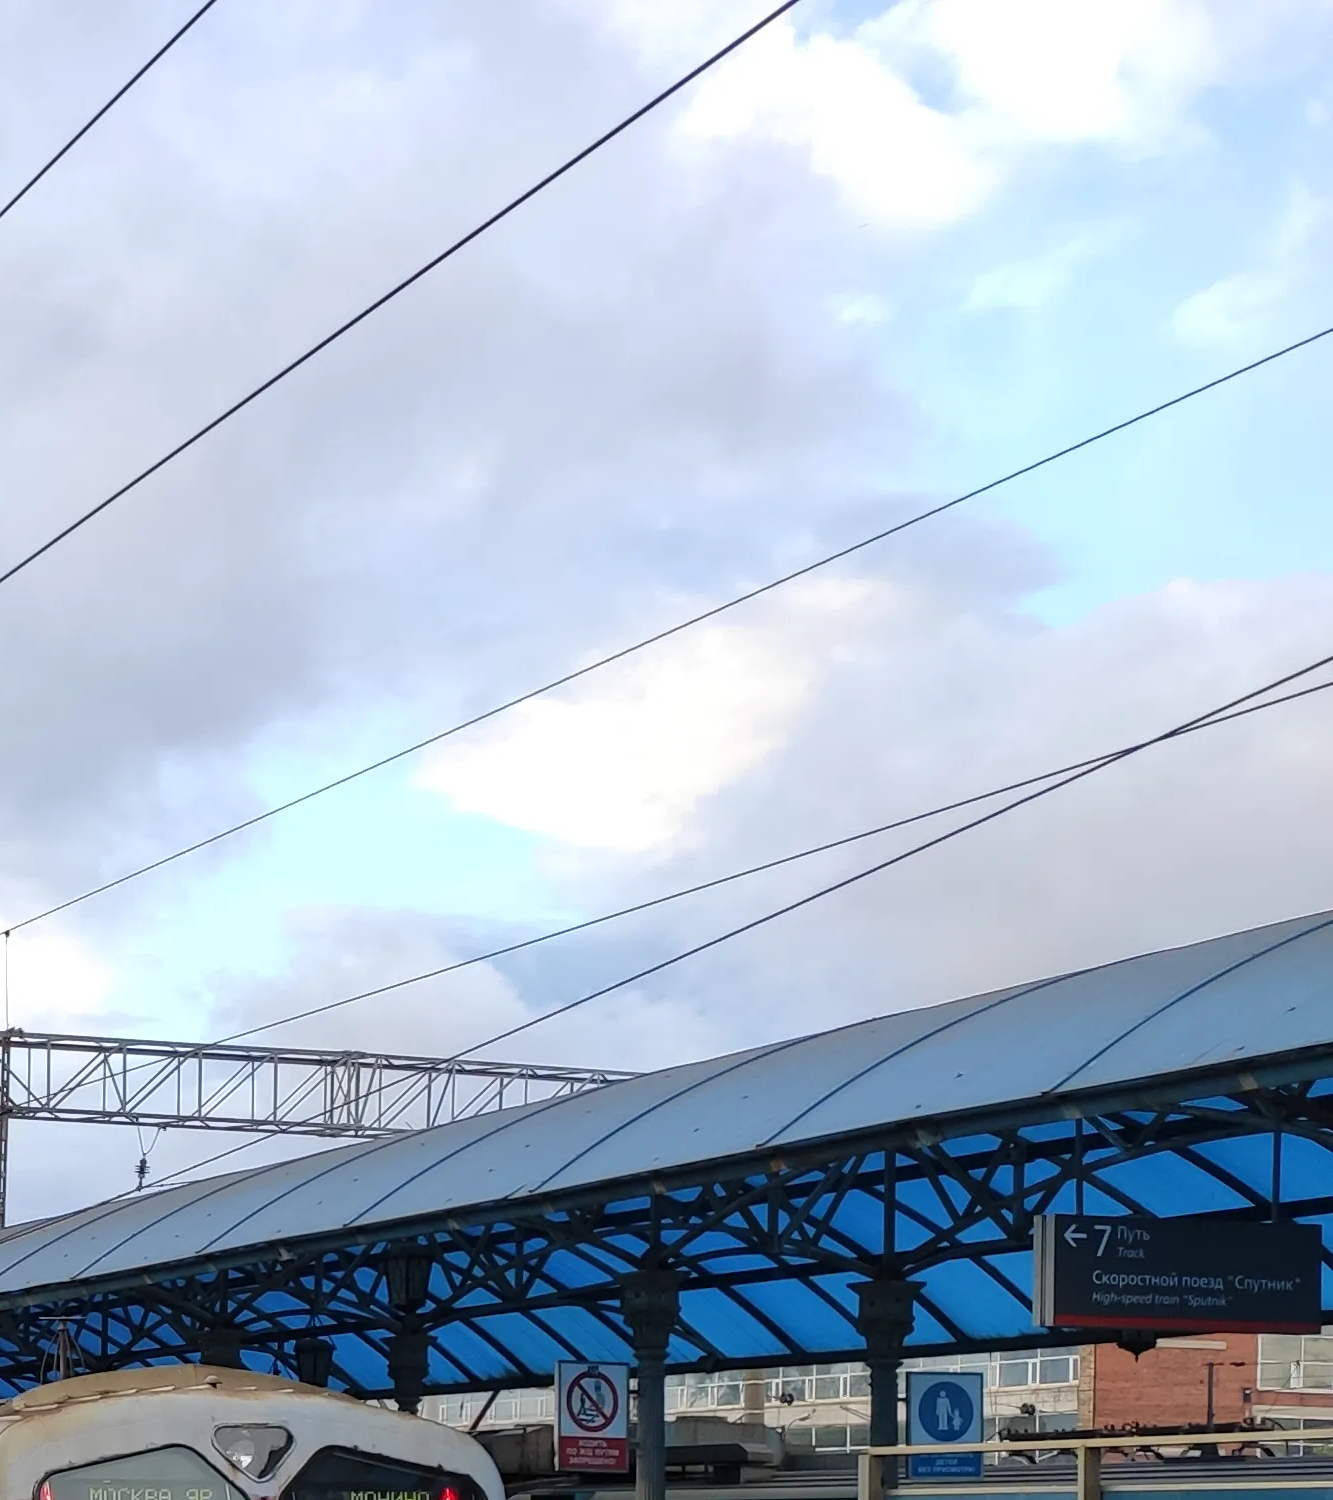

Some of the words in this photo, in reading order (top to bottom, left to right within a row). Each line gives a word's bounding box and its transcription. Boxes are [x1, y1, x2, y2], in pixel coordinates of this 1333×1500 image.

[1093, 1225, 1112, 1257] 7
[1117, 1226, 1150, 1242] Путь
[1118, 1247, 1145, 1259] Track
[1092, 1270, 1178, 1289] Скоростной
[1183, 1276, 1223, 1290] поезд
[1092, 1292, 1152, 1305] High-speed
[1155, 1294, 1179, 1305] train
